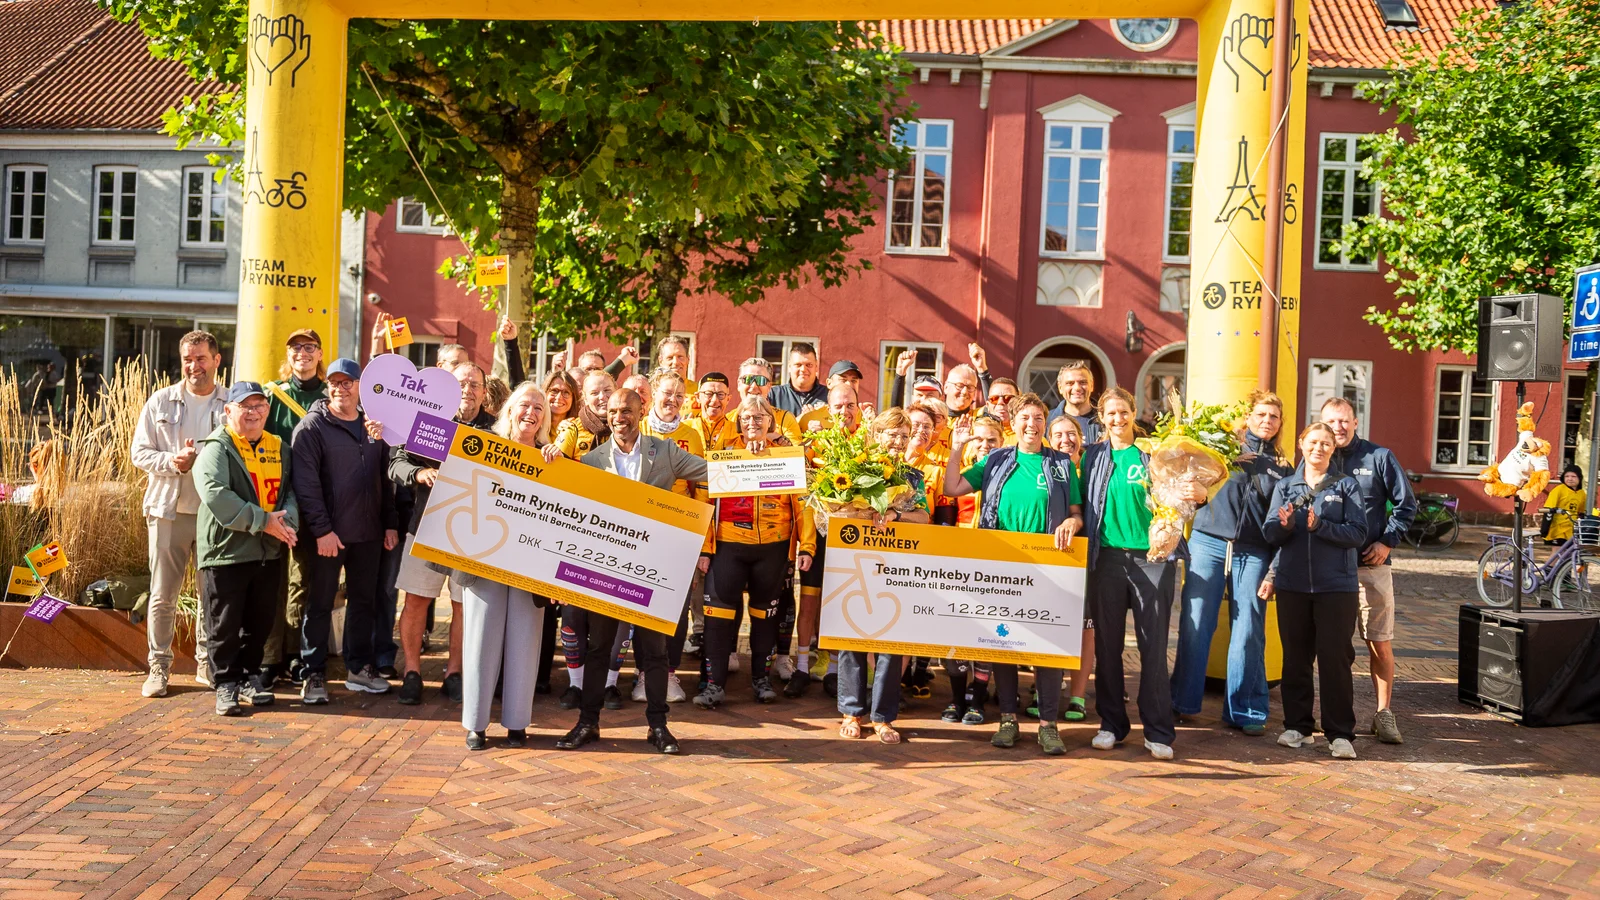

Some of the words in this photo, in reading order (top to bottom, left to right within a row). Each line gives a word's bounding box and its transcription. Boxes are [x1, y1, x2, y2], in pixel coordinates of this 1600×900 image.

[248, 258, 285, 273] TEAM
[249, 272, 317, 289] RYNKEBY
[1229, 281, 1262, 294] TEA
[1232, 296, 1298, 310] RYEBY
[1573, 341, 1578, 352] 1
[1580, 340, 1599, 351] time
[400, 373, 428, 395] Tak
[386, 388, 407, 400] TEAM
[408, 394, 443, 411] RYNKEBY
[416, 428, 449, 443] cancer
[419, 420, 446, 436] børne
[413, 435, 445, 452] fonden
[487, 439, 522, 460] TEAM
[484, 451, 544, 478] RYNKEBY
[491, 482, 526, 503] Team
[529, 494, 588, 524] Rynkeby
[589, 514, 651, 543] Danmark
[656, 501, 685, 515] september
[685, 510, 700, 520] 2026
[495, 499, 537, 518] Donation
[539, 513, 549, 523] til
[550, 515, 637, 551] Børnecancerfonden
[862, 525, 896, 537] TEAM
[863, 536, 920, 550] RYNKEBY
[1031, 545, 1060, 553] september
[518, 533, 542, 549] DKK
[555, 539, 668, 584] 12.223.492,-
[564, 568, 587, 581] børne
[589, 576, 616, 590] cancer
[617, 584, 645, 599] fonden
[875, 563, 910, 576] Team
[913, 566, 971, 584] Rynkeby
[973, 571, 1034, 587] Danmark
[885, 578, 926, 589] Donation
[928, 581, 938, 590] til
[939, 582, 1022, 597] Børnelungefonden
[913, 604, 935, 615] DKK
[947, 602, 1062, 623] 12.223.492,-
[977, 636, 1027, 647] Børnelungefonden
